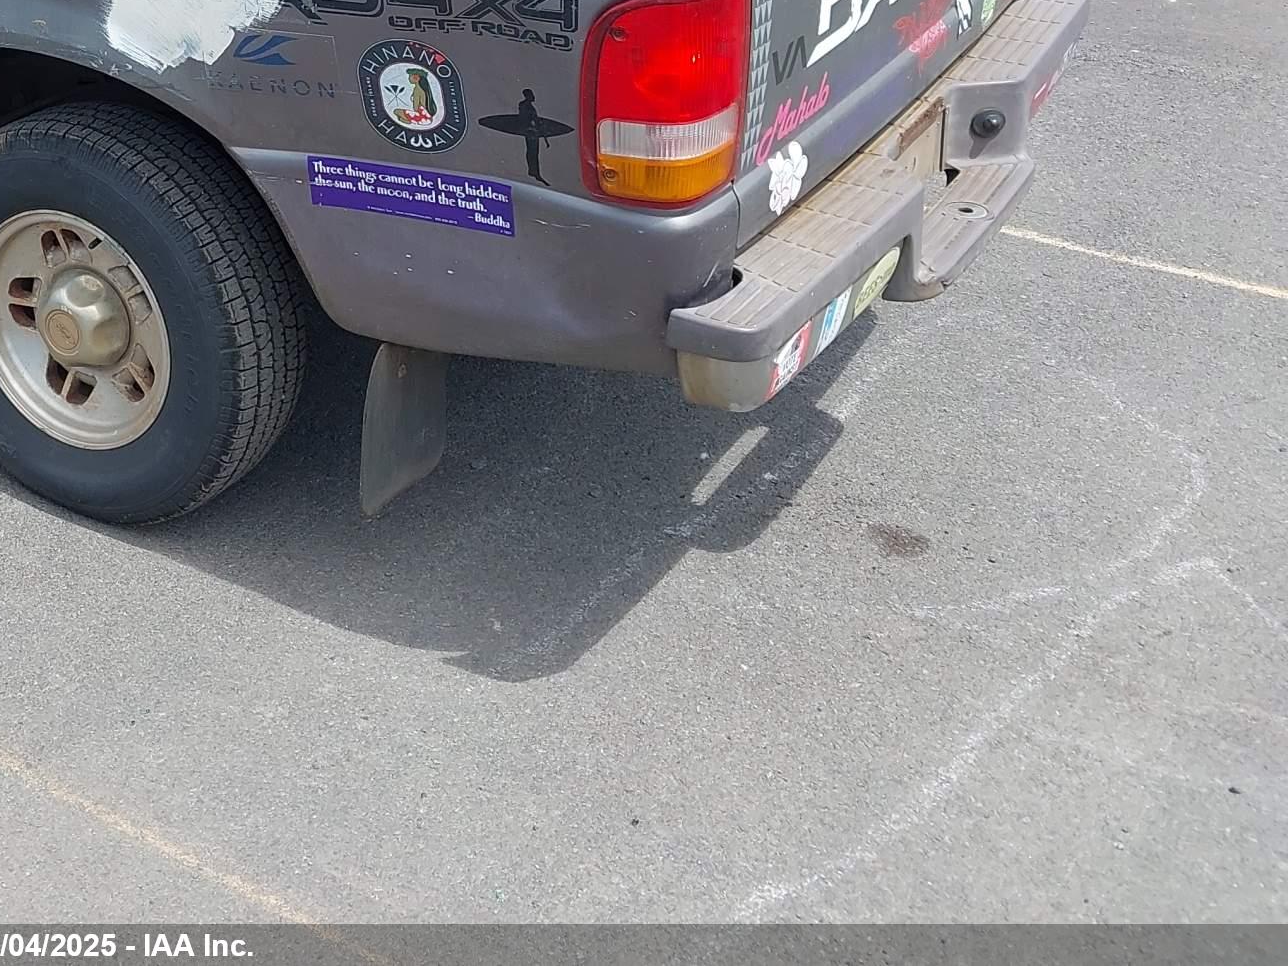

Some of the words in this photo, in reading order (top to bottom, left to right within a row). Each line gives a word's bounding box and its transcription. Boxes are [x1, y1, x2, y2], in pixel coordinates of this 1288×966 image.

[388, 15, 465, 34] OFF
[471, 21, 574, 52] ROAD
[362, 45, 452, 78] HINANO
[378, 119, 459, 148] HAWAII
[755, 71, 831, 166] Mahalo
[312, 160, 344, 175] Three
[344, 163, 377, 184] things
[378, 174, 417, 187] cannot
[417, 175, 434, 189] be
[437, 177, 466, 198] long
[314, 173, 333, 186] the
[334, 180, 356, 193] sun,
[357, 179, 376, 193] the
[376, 186, 413, 201] moon,
[414, 190, 436, 203] and
[437, 192, 457, 207] the
[457, 198, 488, 213] truth.
